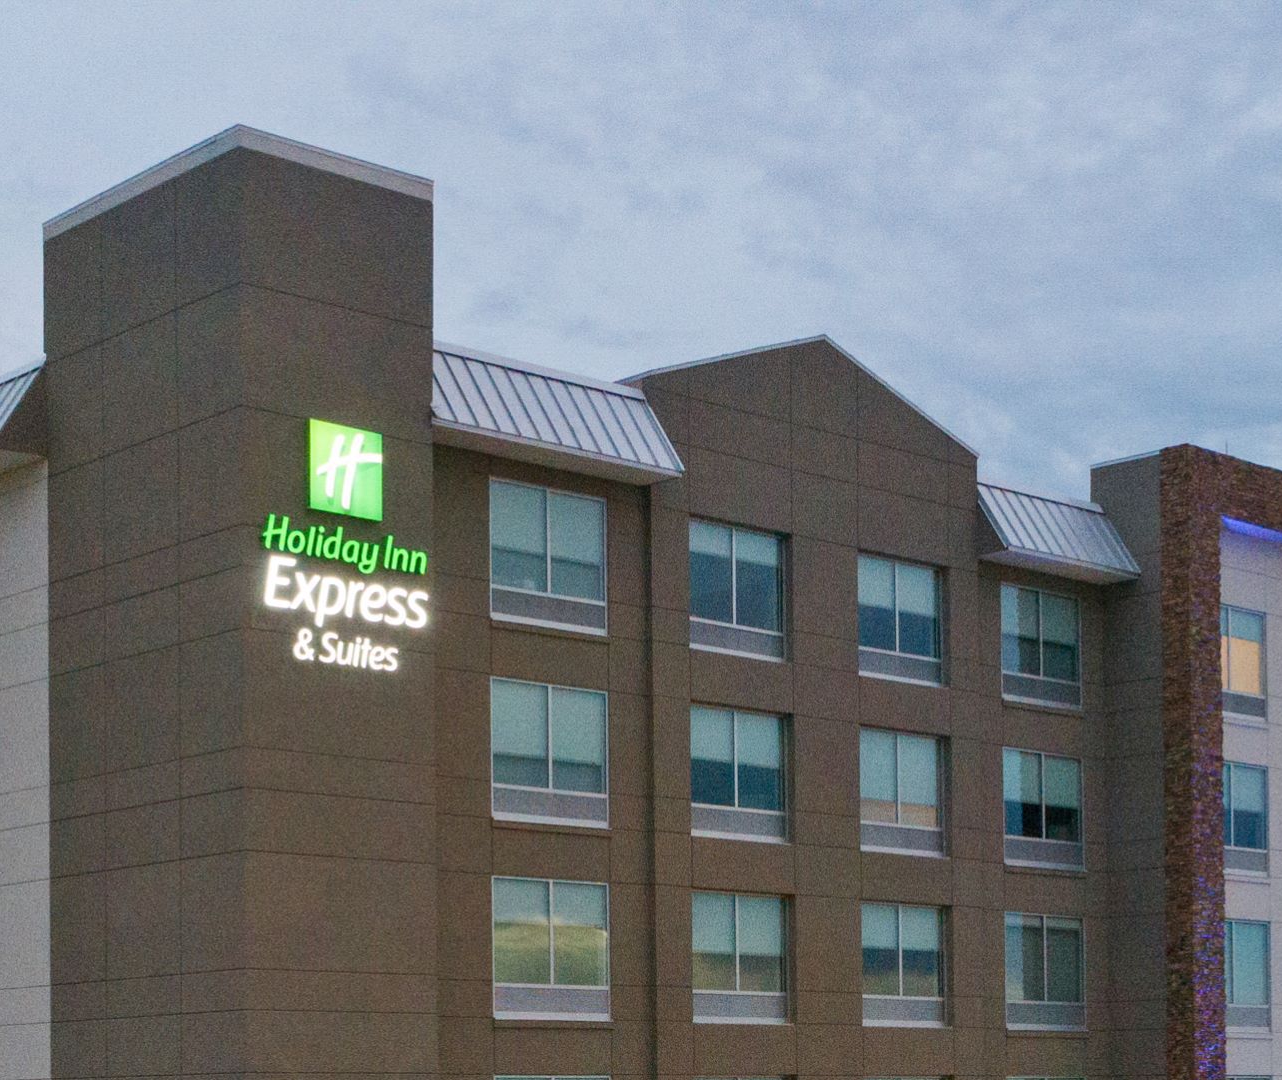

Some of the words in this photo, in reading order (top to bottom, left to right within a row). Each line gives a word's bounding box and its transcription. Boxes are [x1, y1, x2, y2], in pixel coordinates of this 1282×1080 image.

[262, 513, 379, 574] Holiday
[383, 535, 428, 575] Inn
[263, 554, 429, 628] Express
[292, 627, 315, 661] &
[318, 631, 399, 672] Suites
